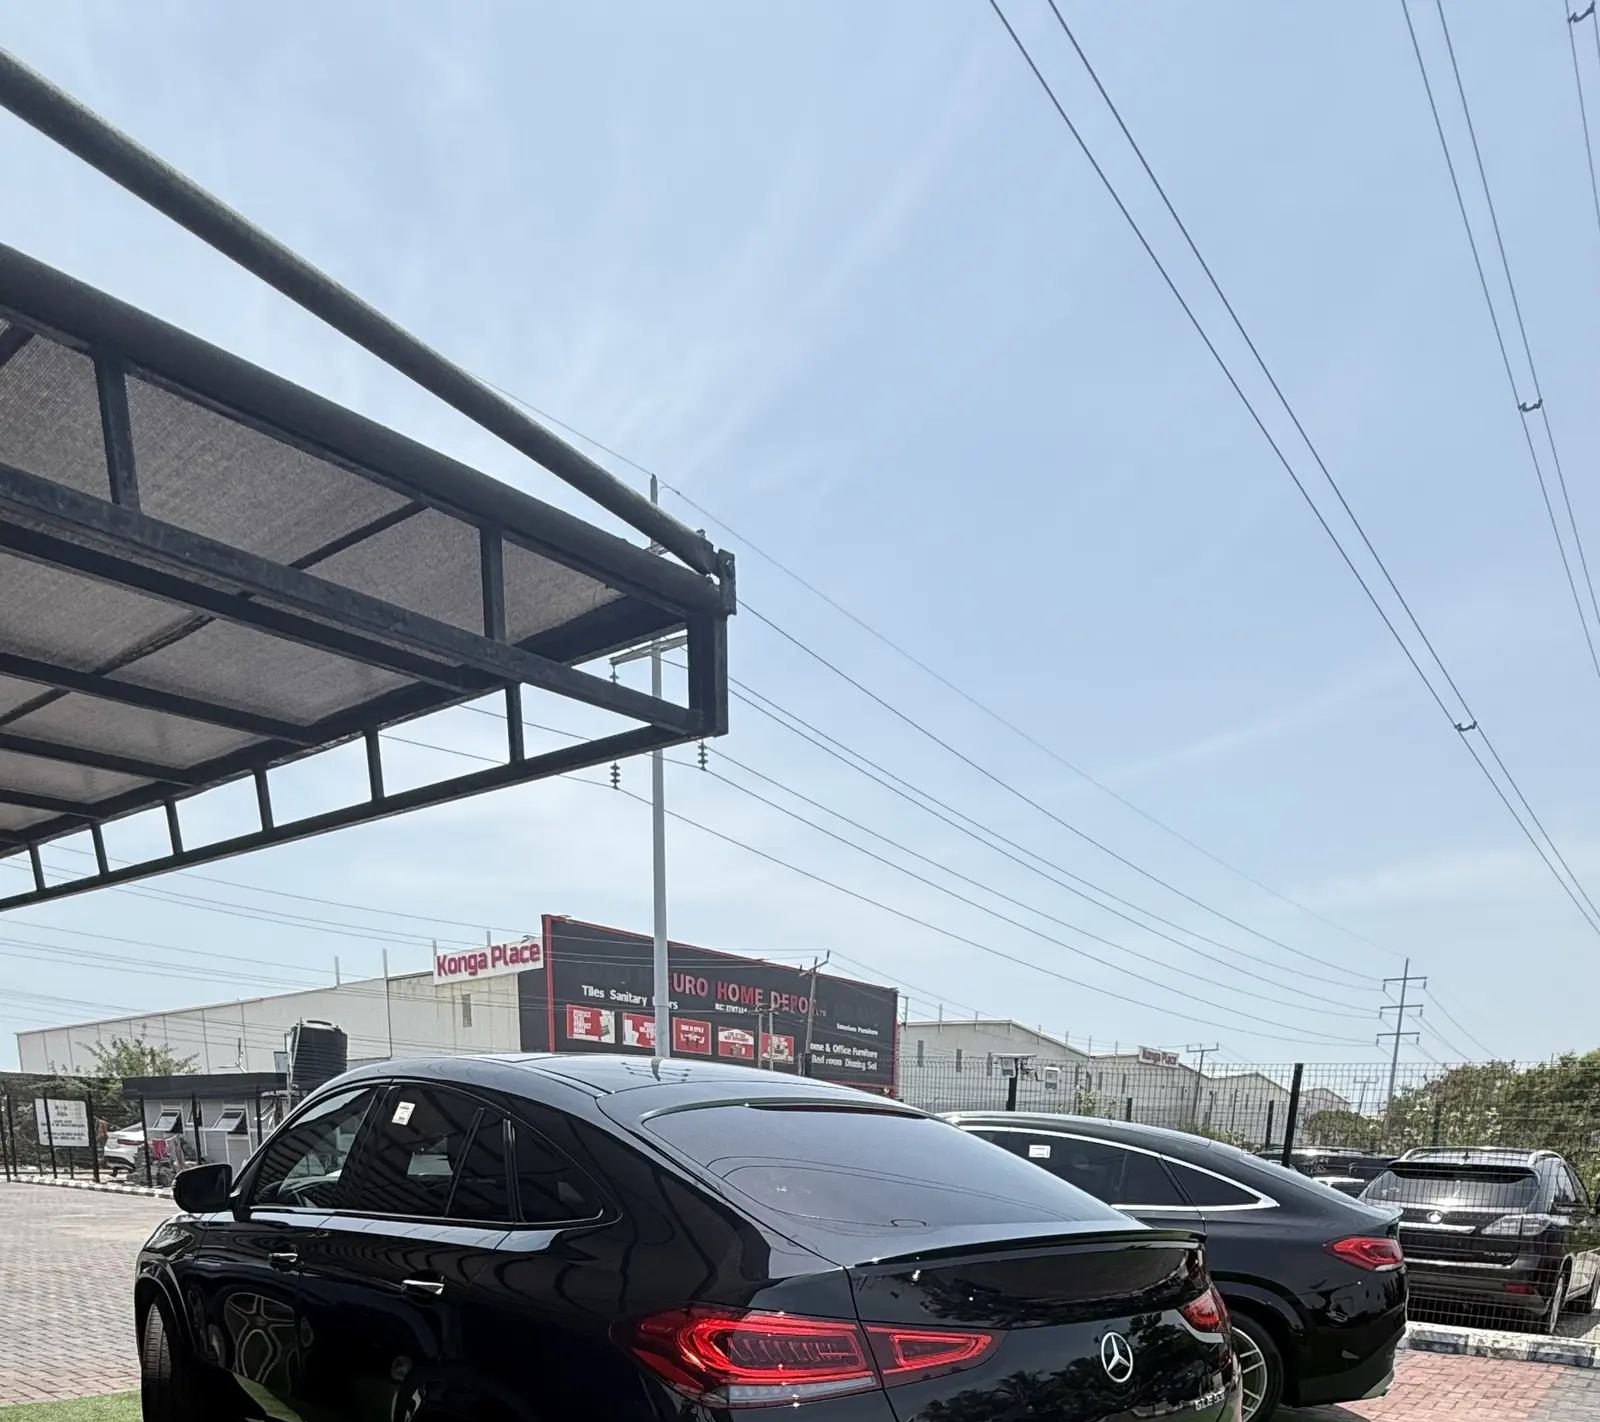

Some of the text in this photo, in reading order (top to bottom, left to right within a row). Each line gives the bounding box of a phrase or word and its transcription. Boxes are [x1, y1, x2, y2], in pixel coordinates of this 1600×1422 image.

[436, 943, 541, 976] Konga Place
[582, 984, 605, 999] Tiles
[610, 989, 648, 1007] Sanitary
[669, 972, 709, 997] URO
[717, 981, 764, 1006] HOME
[770, 990, 812, 1015] DEPO
[809, 1042, 878, 1059] ome & Office Furniture
[825, 1057, 842, 1067] room
